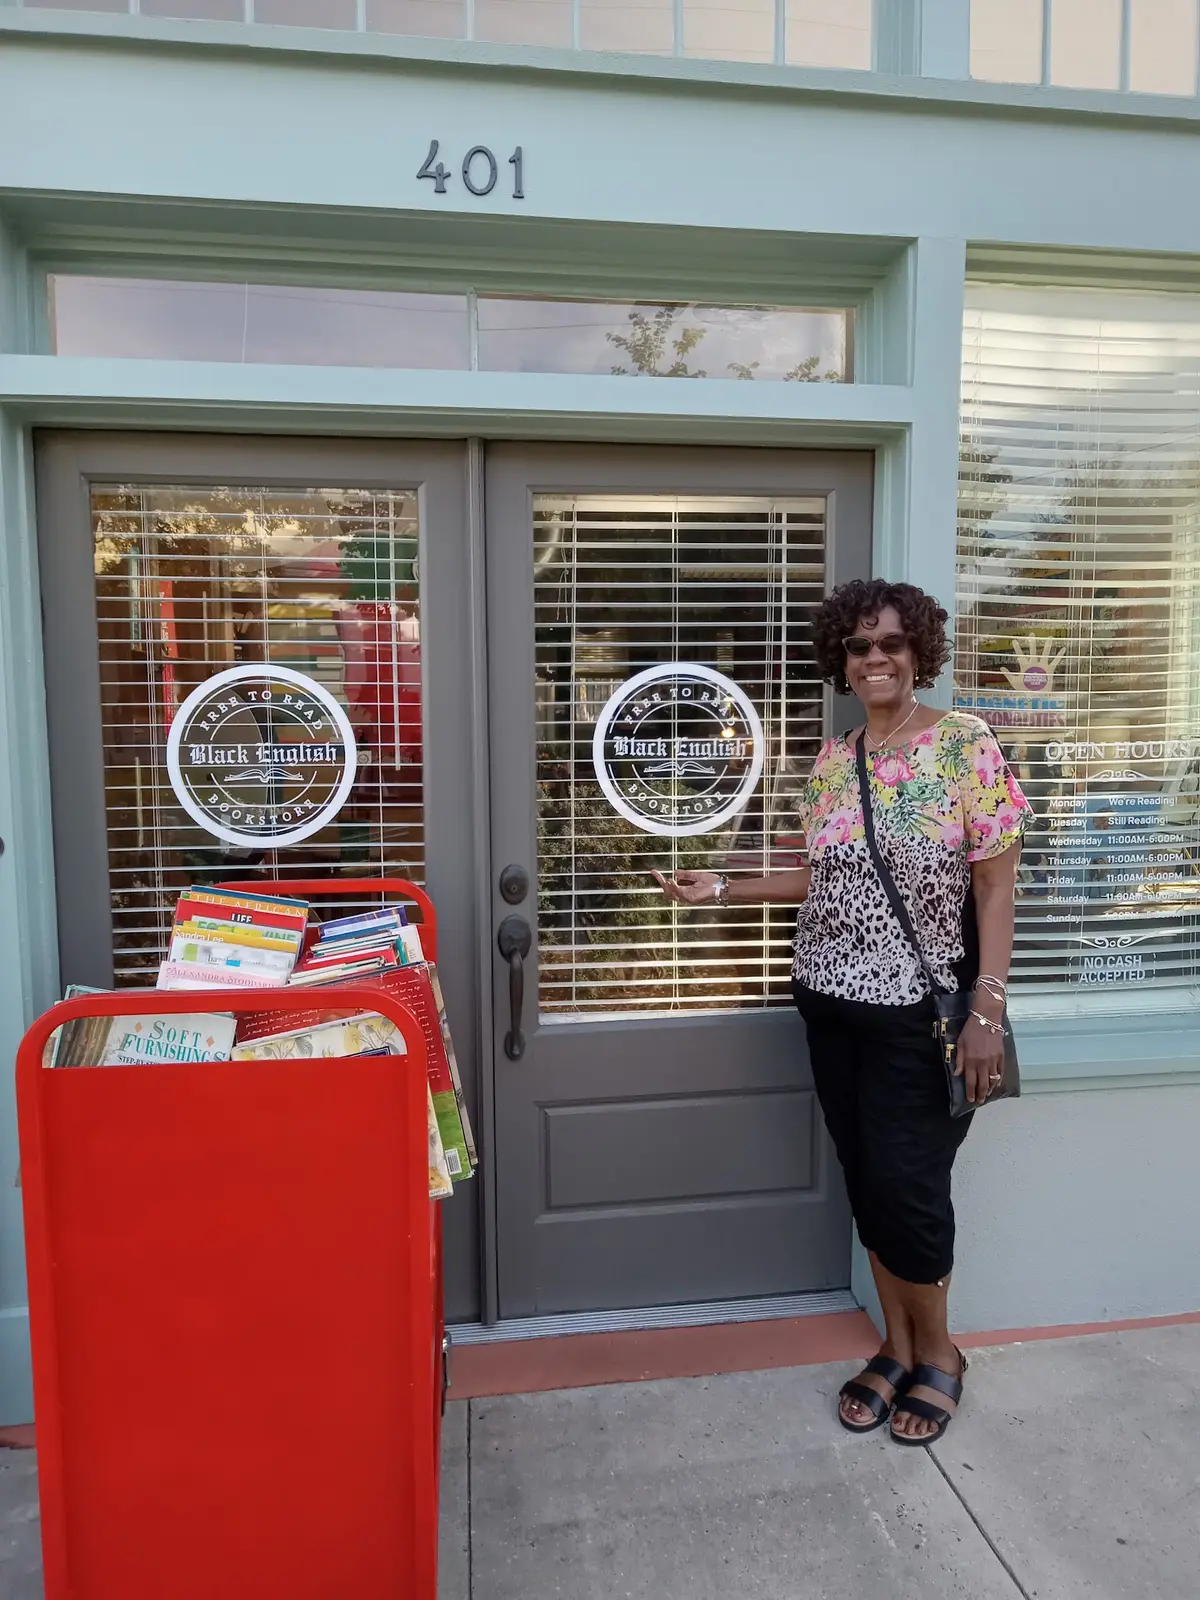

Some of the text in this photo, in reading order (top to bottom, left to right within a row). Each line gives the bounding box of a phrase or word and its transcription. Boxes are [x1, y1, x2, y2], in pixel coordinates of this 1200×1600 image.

[416, 139, 525, 199] 401
[199, 690, 323, 731] FREE TO READ
[624, 692, 662, 725] FREE
[669, 687, 692, 698] TO
[188, 742, 337, 767] Black English
[613, 735, 746, 761] Black English
[1045, 740, 1192, 760] OPEN HOURS
[628, 783, 723, 815] BOOKSTORE
[1049, 796, 1178, 809] Monday We're Reading!
[208, 793, 316, 826] BOOKSTORE
[1049, 815, 1169, 828] Tuesday Still Reading!
[1048, 834, 1184, 847] Wednesday 11:00AM-6:00PM
[1048, 853, 1183, 867] Thursday 11:00AM-6:00PM
[1047, 876, 1076, 886] Friday
[194, 893, 226, 906] THE
[1047, 894, 1090, 905] Saturday
[1046, 914, 1082, 924] Sunday
[1084, 955, 1142, 969] NO CASH
[1080, 969, 1146, 983] ACCEPTED
[149, 1020, 202, 1048] SOFT
[118, 1032, 226, 1063] FURNISHINGS
